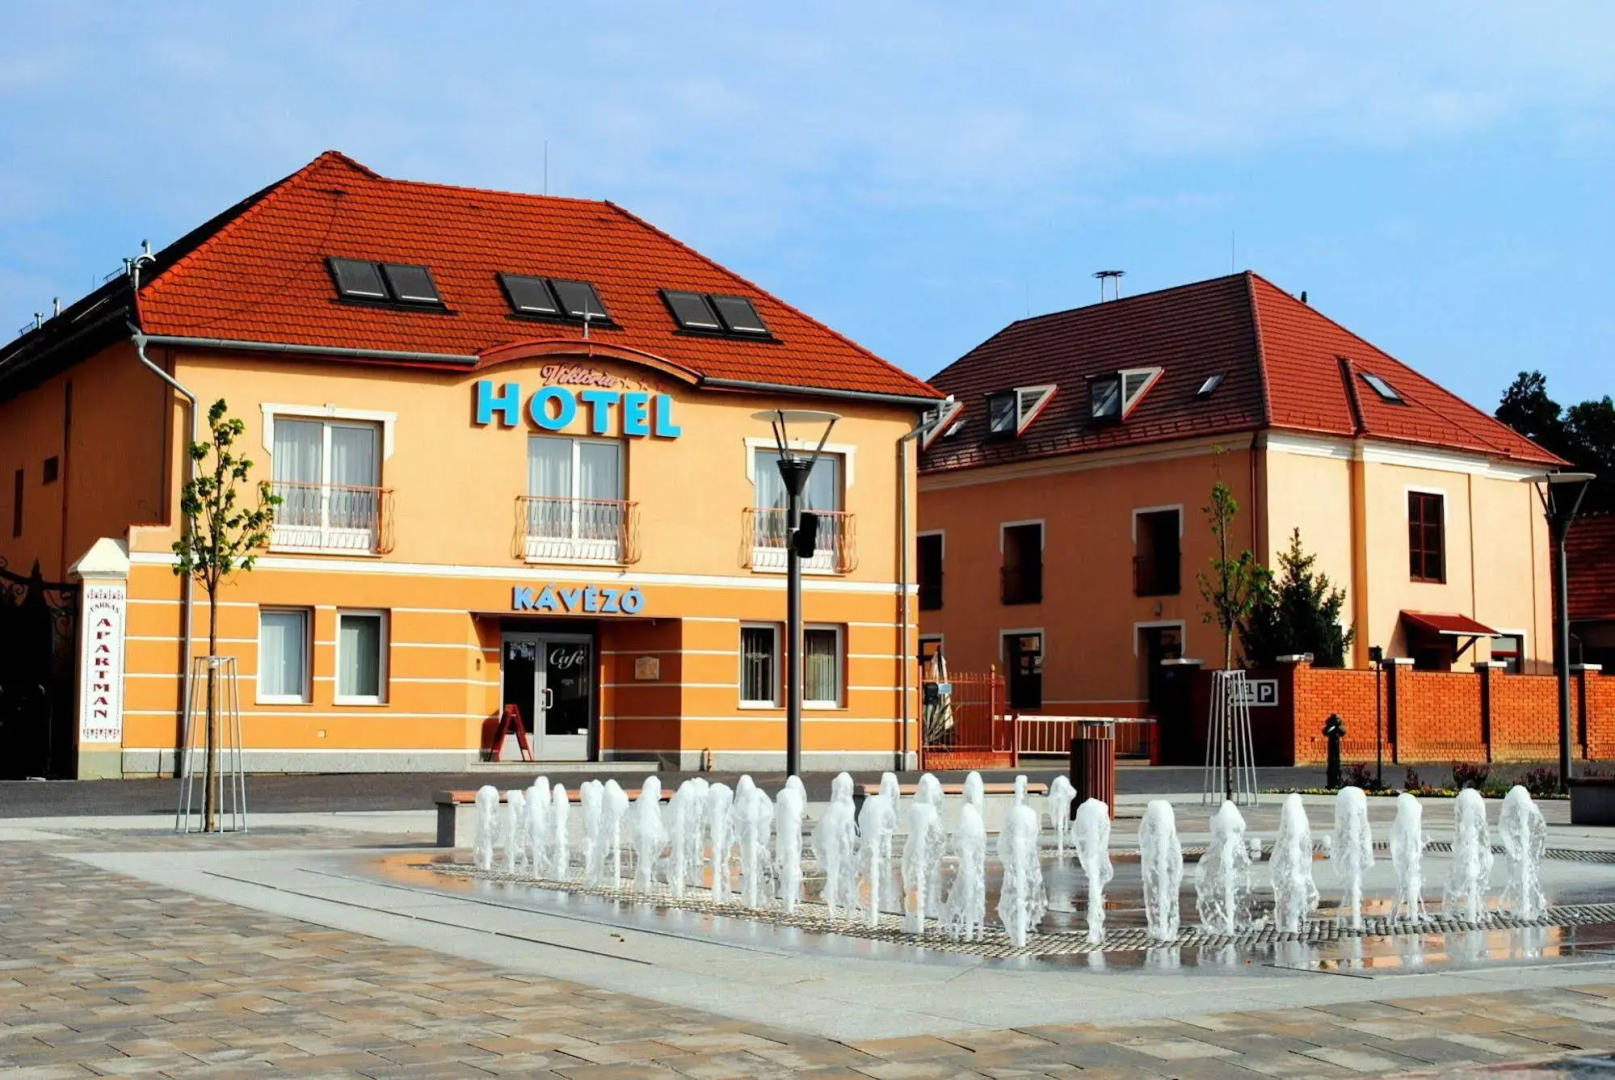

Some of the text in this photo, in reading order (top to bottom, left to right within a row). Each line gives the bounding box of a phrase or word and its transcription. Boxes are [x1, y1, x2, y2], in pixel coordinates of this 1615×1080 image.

[476, 380, 682, 437] HOTEL
[512, 582, 647, 615] KÁVÉZÓ
[93, 618, 112, 718] APARTMAN
